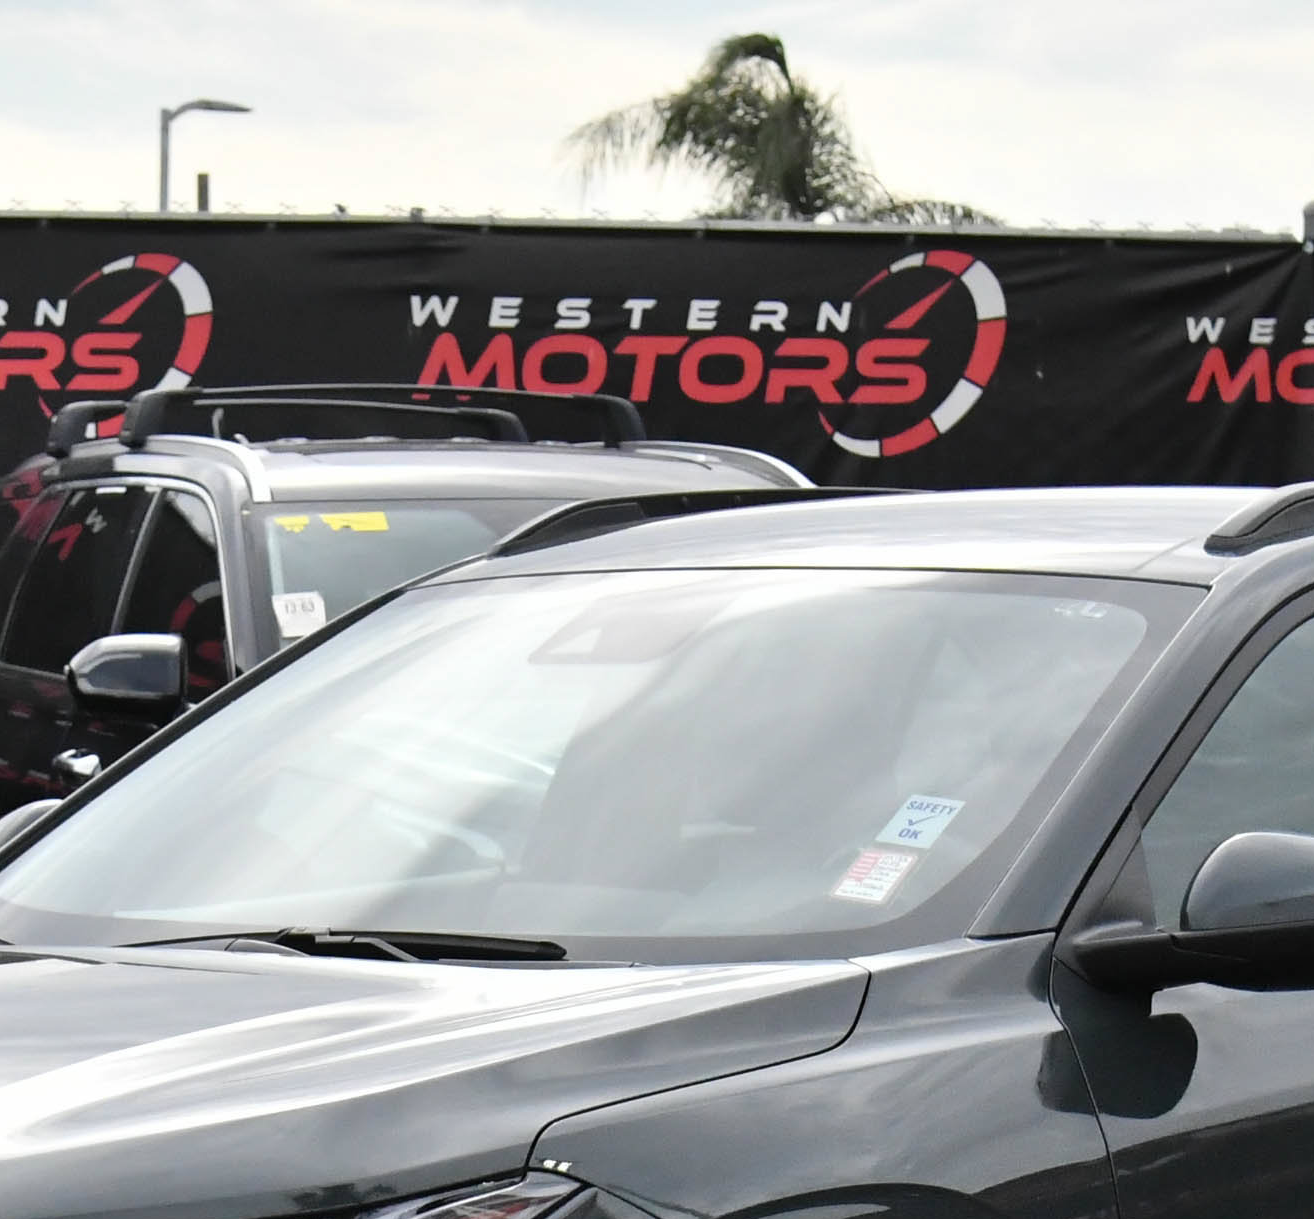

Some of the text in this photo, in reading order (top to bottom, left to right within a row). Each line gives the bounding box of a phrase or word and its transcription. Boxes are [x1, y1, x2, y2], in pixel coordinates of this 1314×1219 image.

[410, 295, 852, 333] WESTERN
[412, 332, 930, 404] MOTORS
[906, 800, 957, 816] SAFETY
[898, 827, 923, 840] OK
